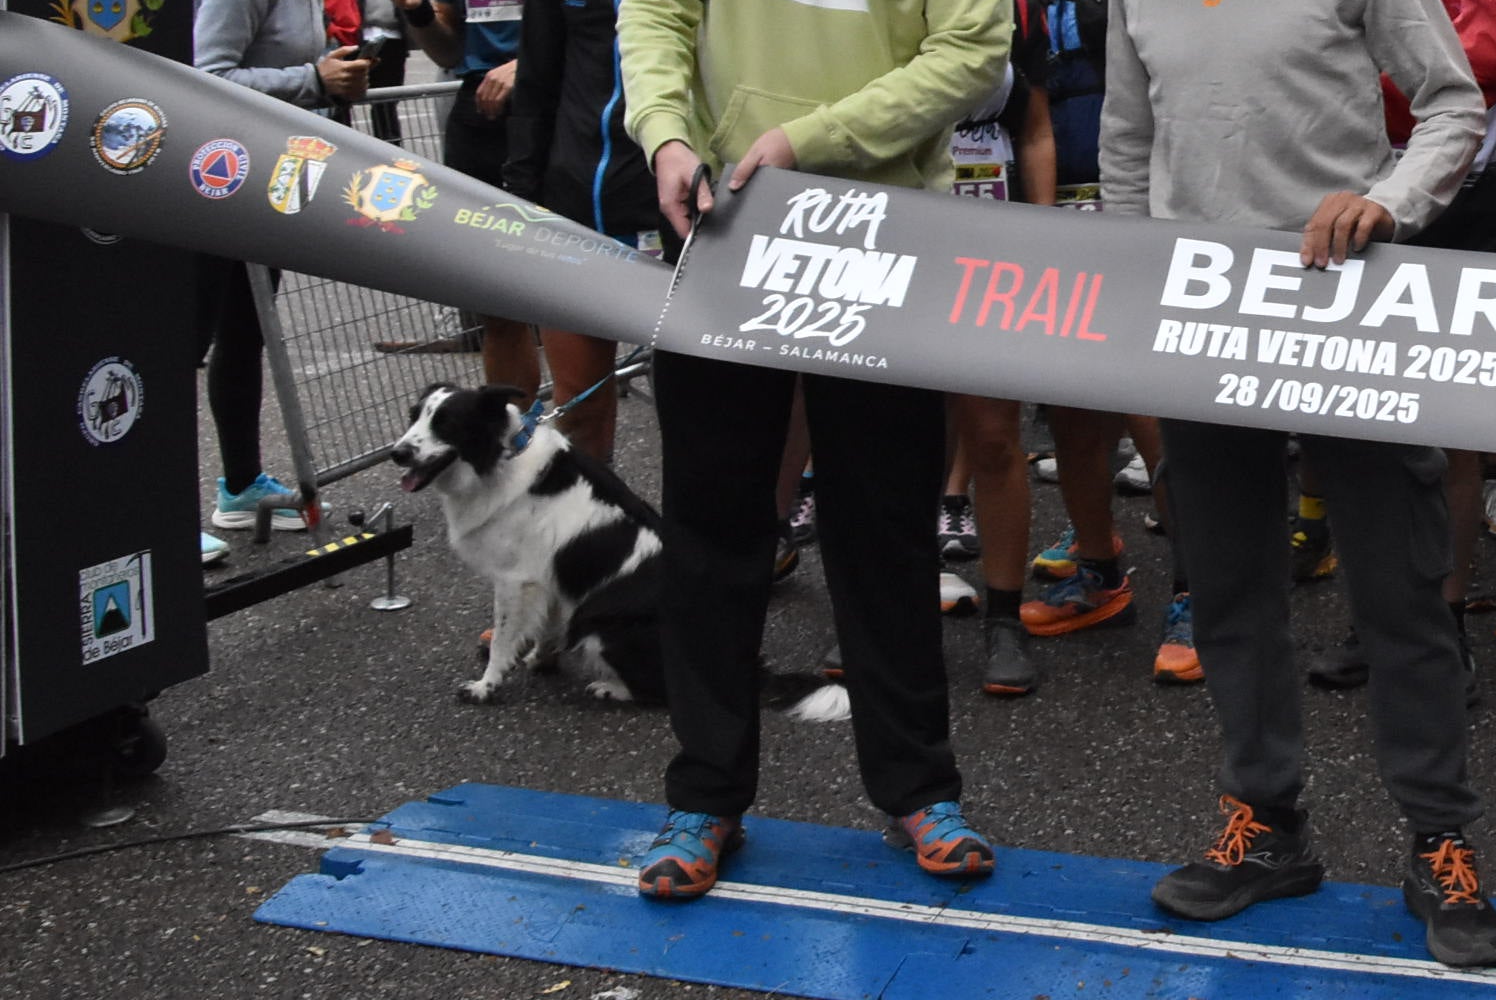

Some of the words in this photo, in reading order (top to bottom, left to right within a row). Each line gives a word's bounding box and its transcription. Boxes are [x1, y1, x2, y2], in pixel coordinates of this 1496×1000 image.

[454, 206, 526, 237] BÉJAR
[533, 226, 640, 264] DEPORTE
[779, 188, 889, 250] RUTA
[739, 234, 918, 308] VETONA
[949, 256, 1108, 342] TRAIL
[738, 294, 873, 347] 2025
[1152, 318, 1249, 361] RUTA
[1256, 329, 1398, 376] VETONA
[701, 333, 757, 351] BÉJAR
[779, 344, 889, 369] SALAMANCA
[1215, 373, 1260, 407] 28
[1261, 378, 1421, 424] /09/2025
[81, 592, 94, 646] SIERRA
[83, 647, 101, 661] de
[103, 634, 134, 656] Béjar
